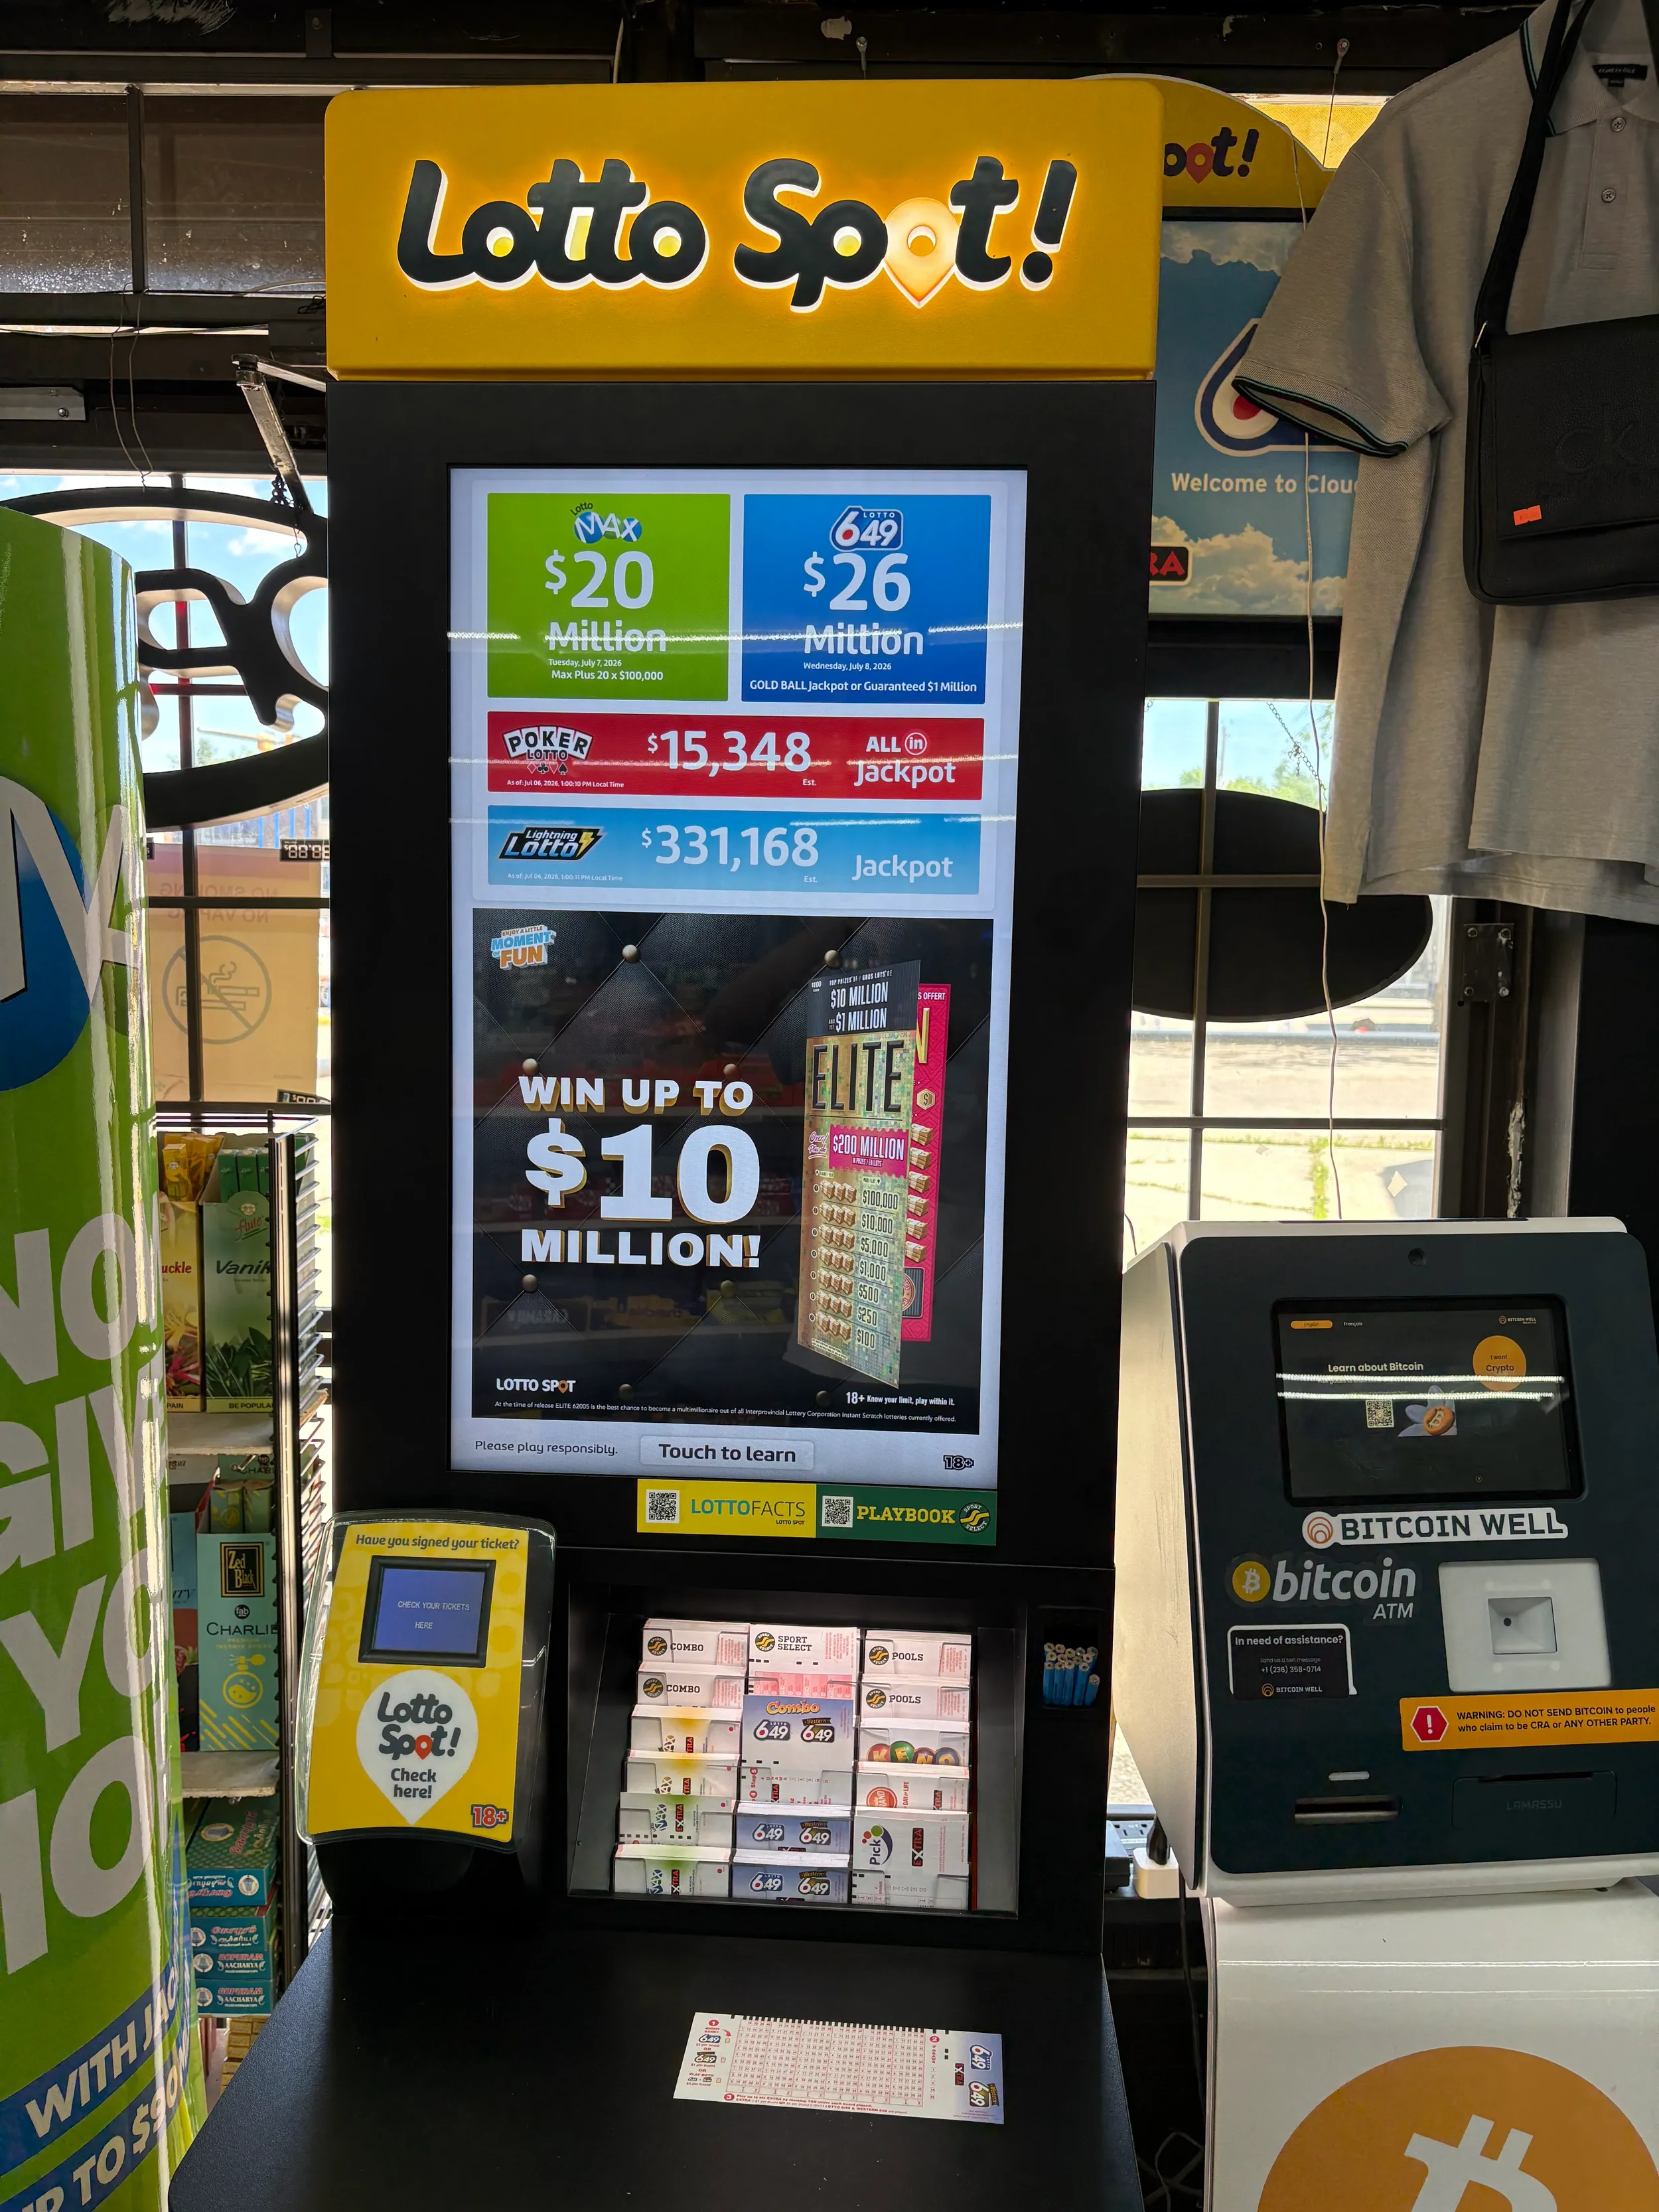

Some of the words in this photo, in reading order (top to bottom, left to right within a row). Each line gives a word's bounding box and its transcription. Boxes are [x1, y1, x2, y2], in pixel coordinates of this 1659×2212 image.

[398, 158, 708, 289] Lotto
[735, 156, 1077, 311] Spot!
[1171, 473, 1267, 494] Welcome
[1275, 475, 1297, 494] to
[570, 502, 593, 516] Lotto
[575, 512, 638, 544] MAX
[835, 511, 898, 546] 649
[545, 550, 654, 608] $20
[804, 552, 910, 611] $26
[549, 620, 667, 651] Million
[804, 625, 924, 655] Million
[552, 670, 572, 679] Max
[574, 670, 595, 680] Plus
[597, 671, 609, 680] 20
[620, 671, 663, 681] $100,000
[849, 662, 863, 671] July
[750, 680, 778, 690] GOLD
[781, 680, 807, 690] BALL
[808, 680, 848, 692] Jackpot
[864, 682, 925, 692] Guaranteed
[928, 681, 938, 692] $1
[941, 682, 977, 692] Million
[508, 731, 588, 755] POKER
[527, 749, 567, 760] LOTTO
[648, 731, 812, 777] $15,348
[855, 761, 956, 788] Jackpot
[526, 830, 578, 841] Lightning
[504, 836, 579, 857] Lotto
[642, 824, 819, 871] $331,168
[853, 854, 953, 881] Jackpot
[492, 932, 551, 950] MOMENT
[501, 945, 542, 967] FUN
[831, 988, 845, 1009] $10
[849, 982, 889, 1007] MILLION
[836, 1011, 845, 1032] $1
[848, 1007, 887, 1031] MILLION
[812, 1040, 904, 1112] ELITE
[518, 1076, 605, 1109] WIN
[622, 1079, 679, 1112] UP
[693, 1081, 753, 1113] TO
[833, 1134, 857, 1155] $200
[860, 1136, 904, 1160] MILLION
[526, 1118, 760, 1224] $10
[863, 1190, 898, 1210] $100,000
[862, 1214, 893, 1234] $10,000
[522, 1229, 760, 1268] MILLION!
[861, 1238, 889, 1258] $5,000
[860, 1261, 887, 1281] $1,000
[859, 1284, 879, 1303] $500
[858, 1308, 877, 1326] $250
[857, 1331, 875, 1349] $100
[1329, 1363, 1356, 1372] Learn
[1358, 1363, 1387, 1372] about
[1389, 1362, 1423, 1371] Bitcoin
[1486, 1363, 1514, 1372] Crypto
[496, 1378, 539, 1392] LOTTO
[542, 1380, 576, 1393] SPOT
[846, 1392, 865, 1404] 18+
[899, 1396, 914, 1405] limit,
[916, 1396, 928, 1406] play
[475, 1441, 514, 1451] Please
[518, 1441, 543, 1453] play
[547, 1443, 618, 1455] responsibly.
[659, 1443, 716, 1460] Touch
[721, 1445, 741, 1461] to
[747, 1446, 796, 1462] learn
[943, 1455, 974, 1470] 18+
[691, 1499, 806, 1517] LOTTOFACTS
[857, 1506, 955, 1524] PLAYBOOK
[1341, 1515, 1471, 1541] BITCOIN
[1479, 1511, 1563, 1536] WELL
[356, 1534, 386, 1546] Have
[388, 1538, 409, 1548] you
[412, 1536, 450, 1549] signed
[451, 1538, 478, 1550] your
[480, 1538, 520, 1550] ticket?
[228, 1550, 246, 1570] Zed
[234, 1569, 257, 1589] Black
[1273, 1557, 1416, 1601] bitcoin
[1373, 1603, 1413, 1620] ATM
[1236, 1637, 1244, 1645] In
[1247, 1636, 1271, 1645] need
[1273, 1636, 1283, 1645] of
[1285, 1635, 1343, 1644] assistance?
[892, 1653, 923, 1661] POOLS
[1270, 1665, 1288, 1674] (236)
[666, 1684, 700, 1693] COMBO
[377, 1692, 453, 1724] Lotto
[766, 1700, 820, 1715] Combo
[889, 1695, 921, 1704] POOLS
[1457, 1711, 1505, 1720] WARNING:
[1546, 1708, 1572, 1717] SEND
[1575, 1707, 1613, 1716] BITCOIN
[1626, 1705, 1655, 1716] people
[1586, 1718, 1617, 1727] OTHER
[1621, 1717, 1651, 1726] PARTY.
[379, 1724, 461, 1760] Spot!
[873, 1747, 955, 1765] KENO
[391, 1767, 437, 1783] Check
[394, 1785, 432, 1799] here!
[1506, 1799, 1562, 1810] LAMASSU
[471, 1805, 508, 1828] 18+
[869, 1840, 881, 1866] Pick
[912, 1828, 924, 1866] EXTRA
[25, 2020, 137, 2138] WITH
[73, 2135, 125, 2206] TO
